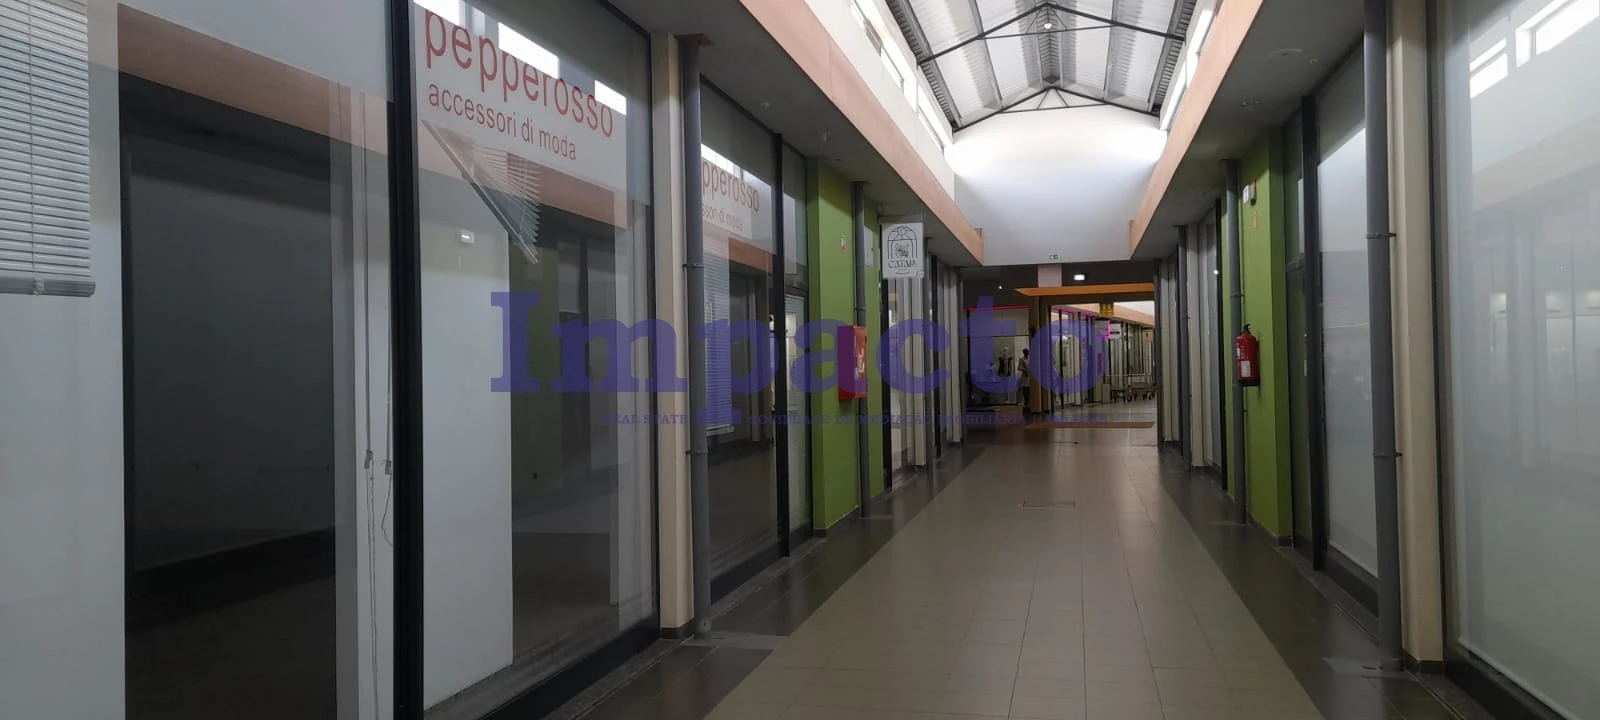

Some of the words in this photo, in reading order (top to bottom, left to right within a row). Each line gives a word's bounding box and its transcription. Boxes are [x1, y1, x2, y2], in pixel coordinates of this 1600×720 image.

[425, 8, 614, 138] pepperosso
[428, 82, 517, 139] accessori
[521, 115, 534, 143] di
[539, 130, 577, 160] moda
